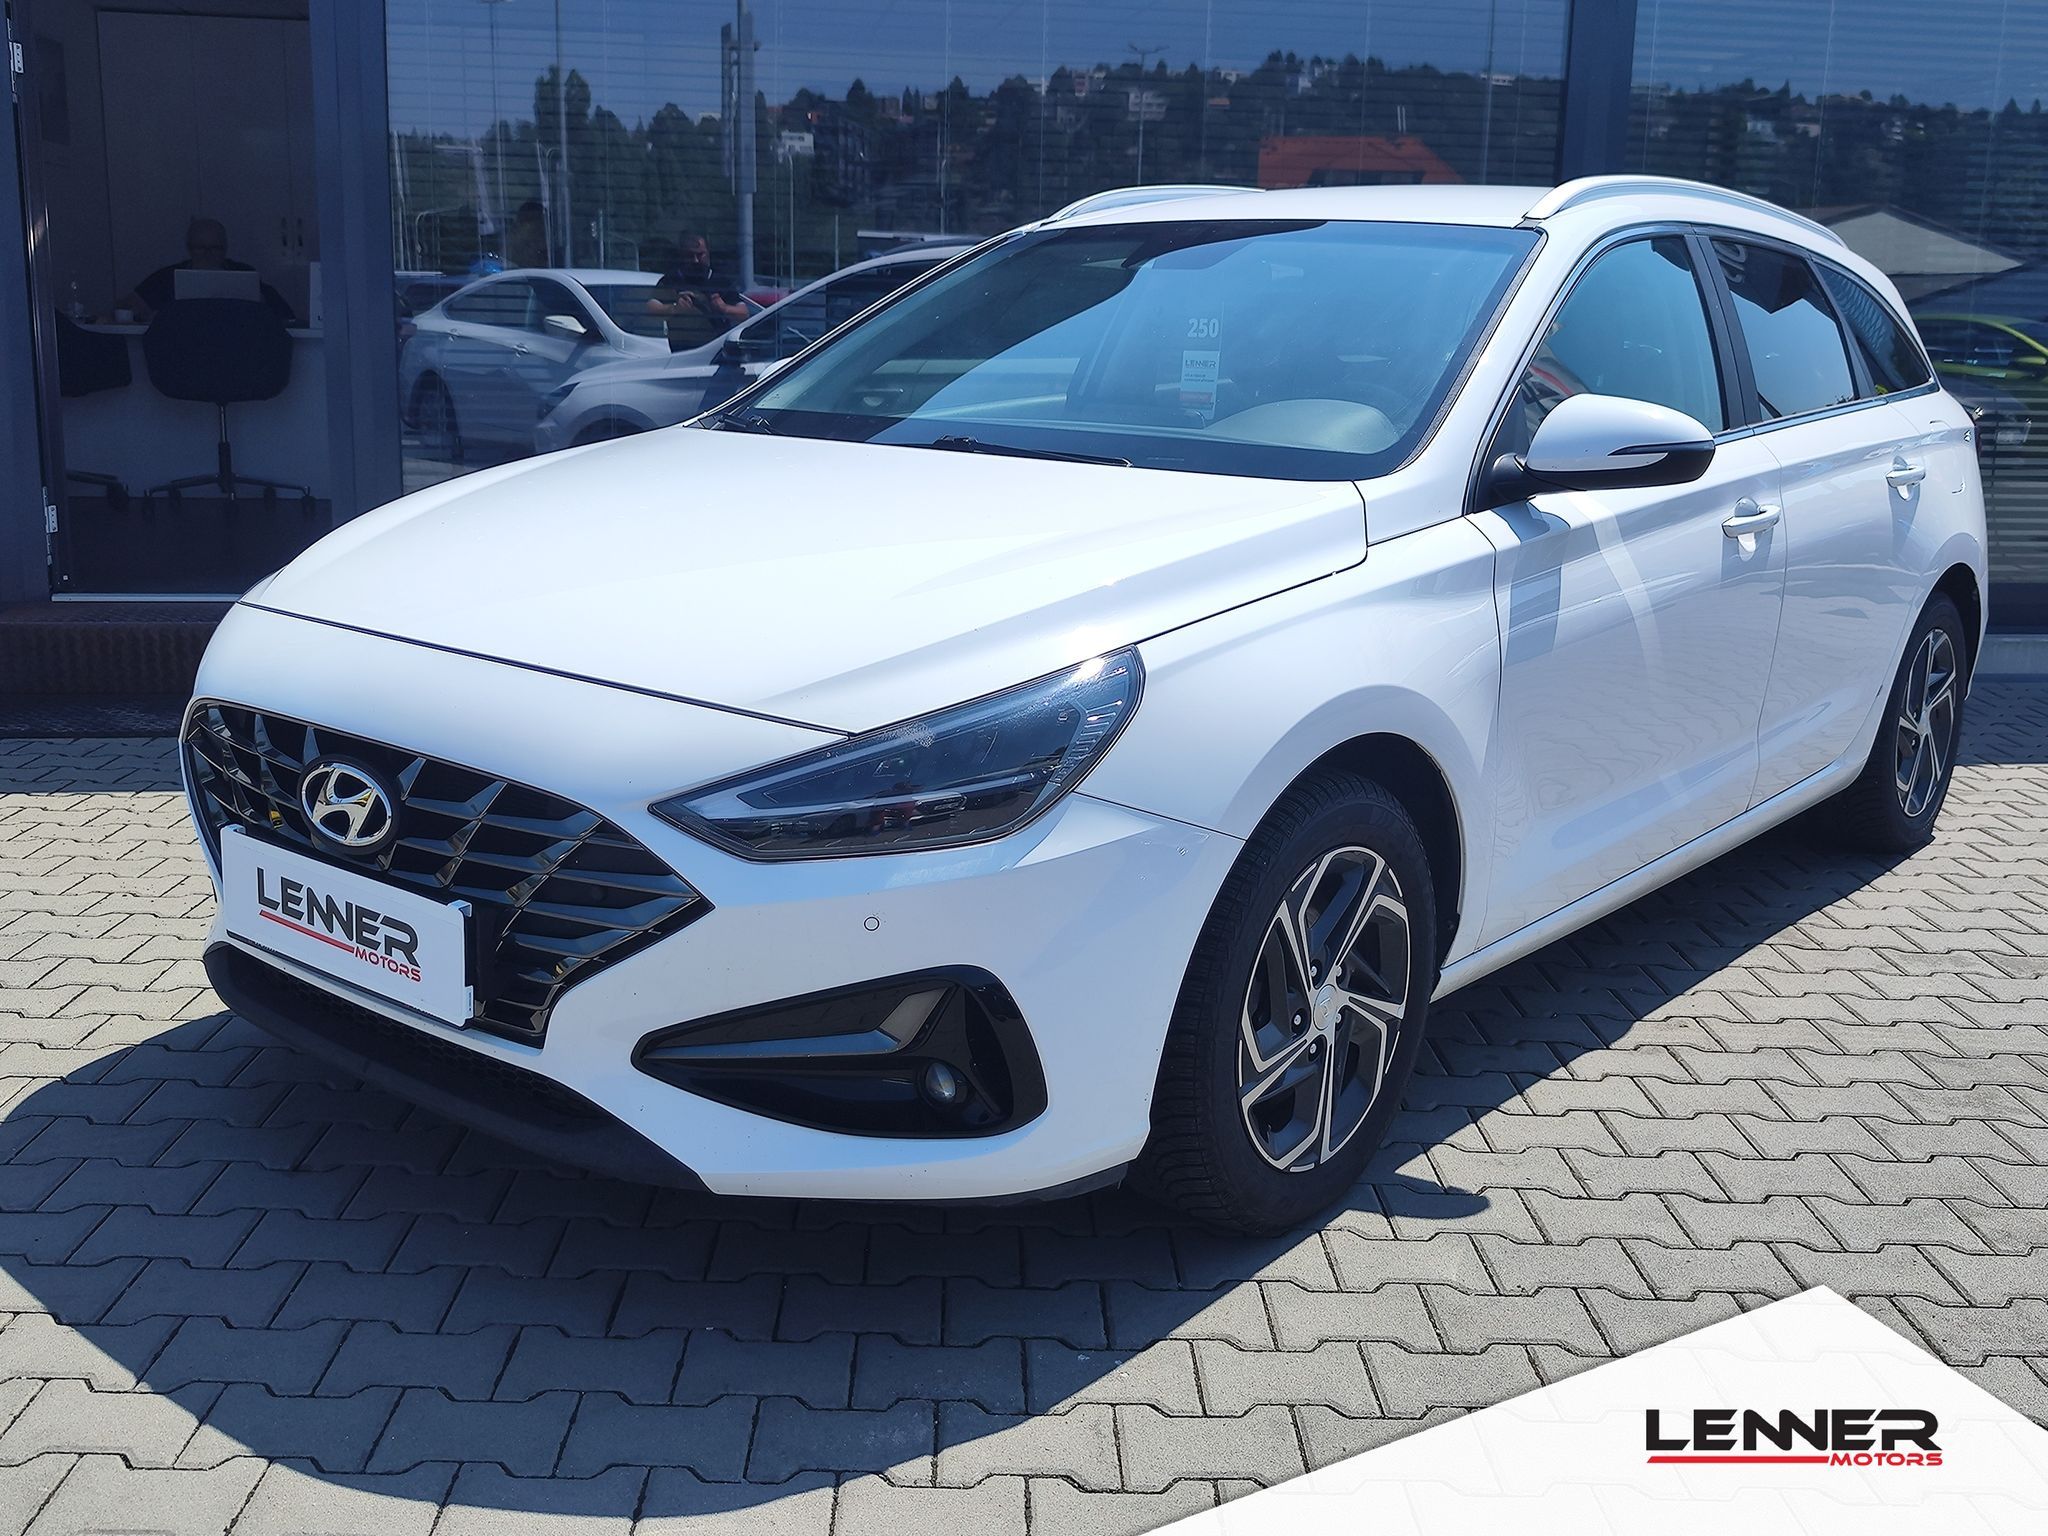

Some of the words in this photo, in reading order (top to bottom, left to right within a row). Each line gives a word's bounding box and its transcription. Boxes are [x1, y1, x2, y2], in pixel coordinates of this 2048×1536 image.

[1187, 318, 1219, 338] 250
[257, 867, 421, 967] LENNER
[355, 945, 422, 982] MOTORS
